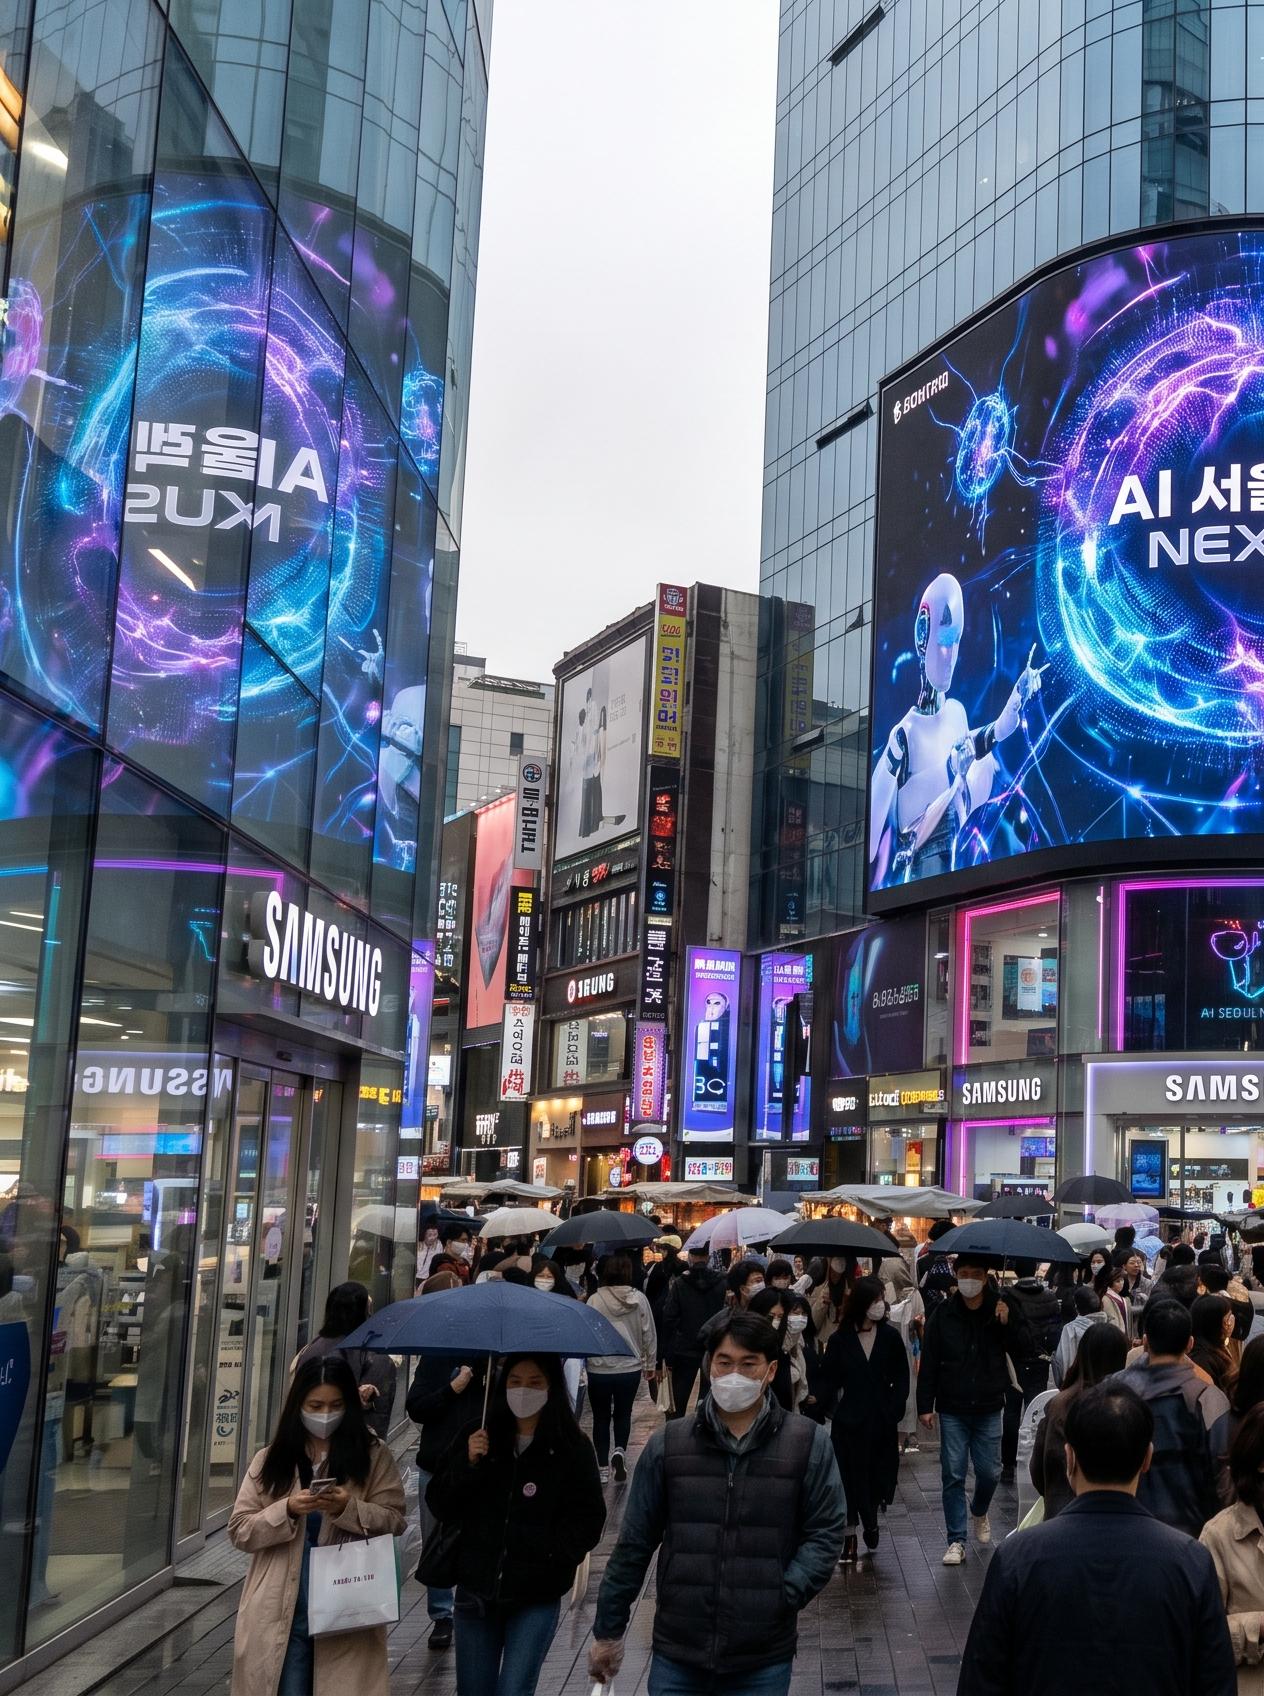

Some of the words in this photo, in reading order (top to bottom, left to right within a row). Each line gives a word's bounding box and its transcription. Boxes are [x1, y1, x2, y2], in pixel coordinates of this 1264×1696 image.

[1108, 469, 1172, 526] AI
[263, 890, 383, 1017] SAMSUNG
[962, 1077, 1041, 1105] SAMSUNG
